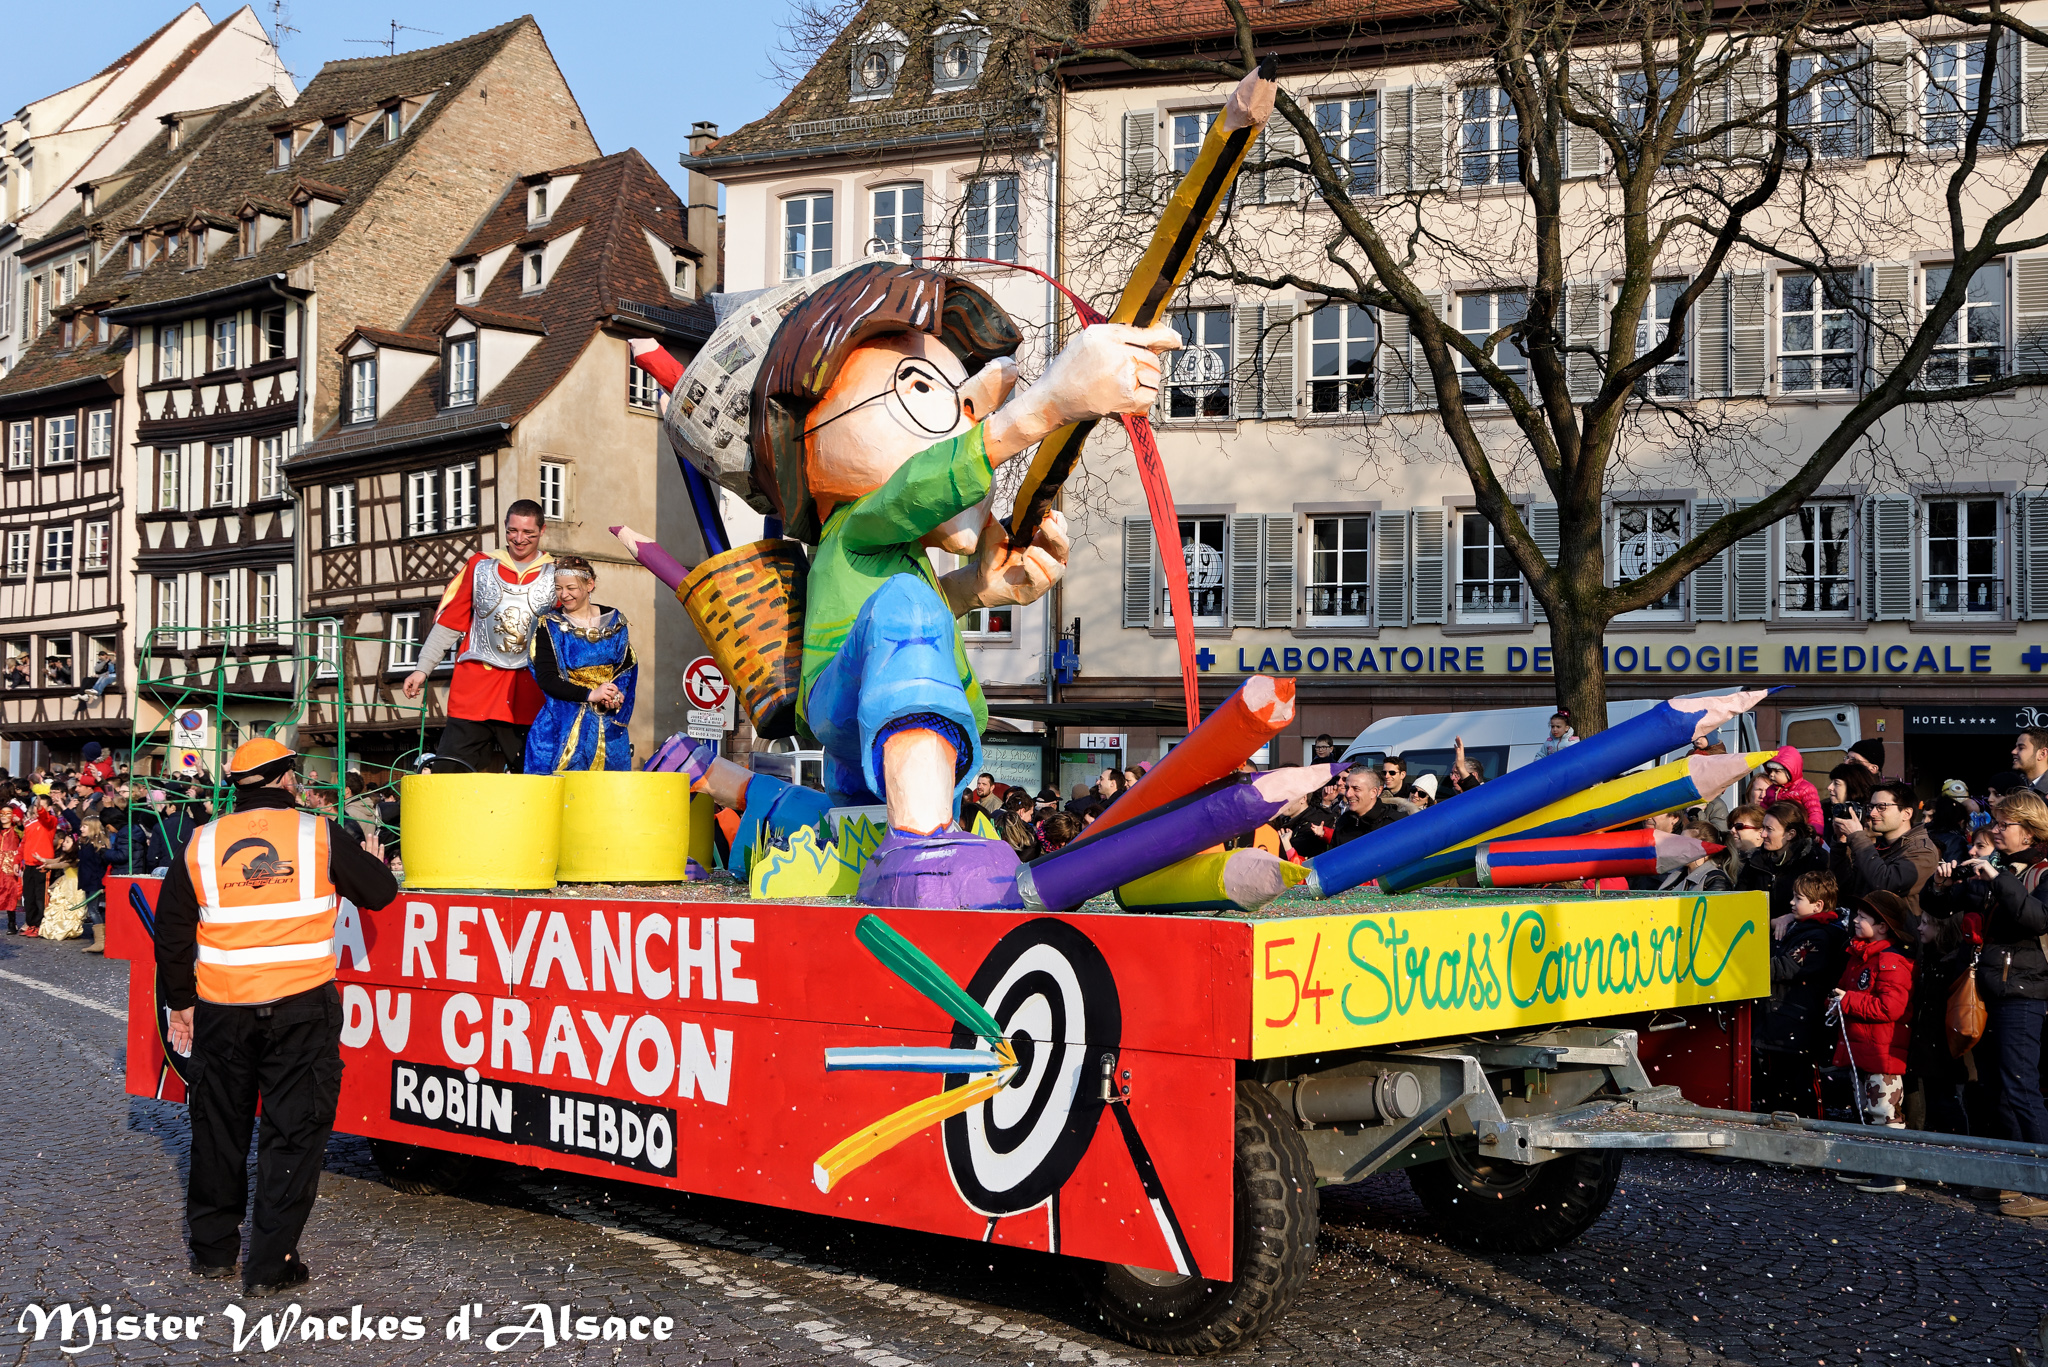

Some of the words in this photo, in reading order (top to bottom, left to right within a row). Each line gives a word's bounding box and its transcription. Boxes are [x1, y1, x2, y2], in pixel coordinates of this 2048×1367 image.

[1238, 646, 1485, 673] LABORATOIRE
[1507, 646, 1552, 672] DE
[1603, 645, 1759, 673] IOLOGIE
[1784, 645, 1992, 673] MEDICALE
[1912, 716, 1955, 724] HOTEL
[223, 877, 294, 890] protection
[335, 897, 371, 972] A
[401, 901, 759, 1004] REVANCHE
[1264, 932, 1334, 1028] 54
[339, 984, 411, 1054] DU
[441, 992, 734, 1106] CRAYON
[549, 1095, 673, 1169] HEBDO
